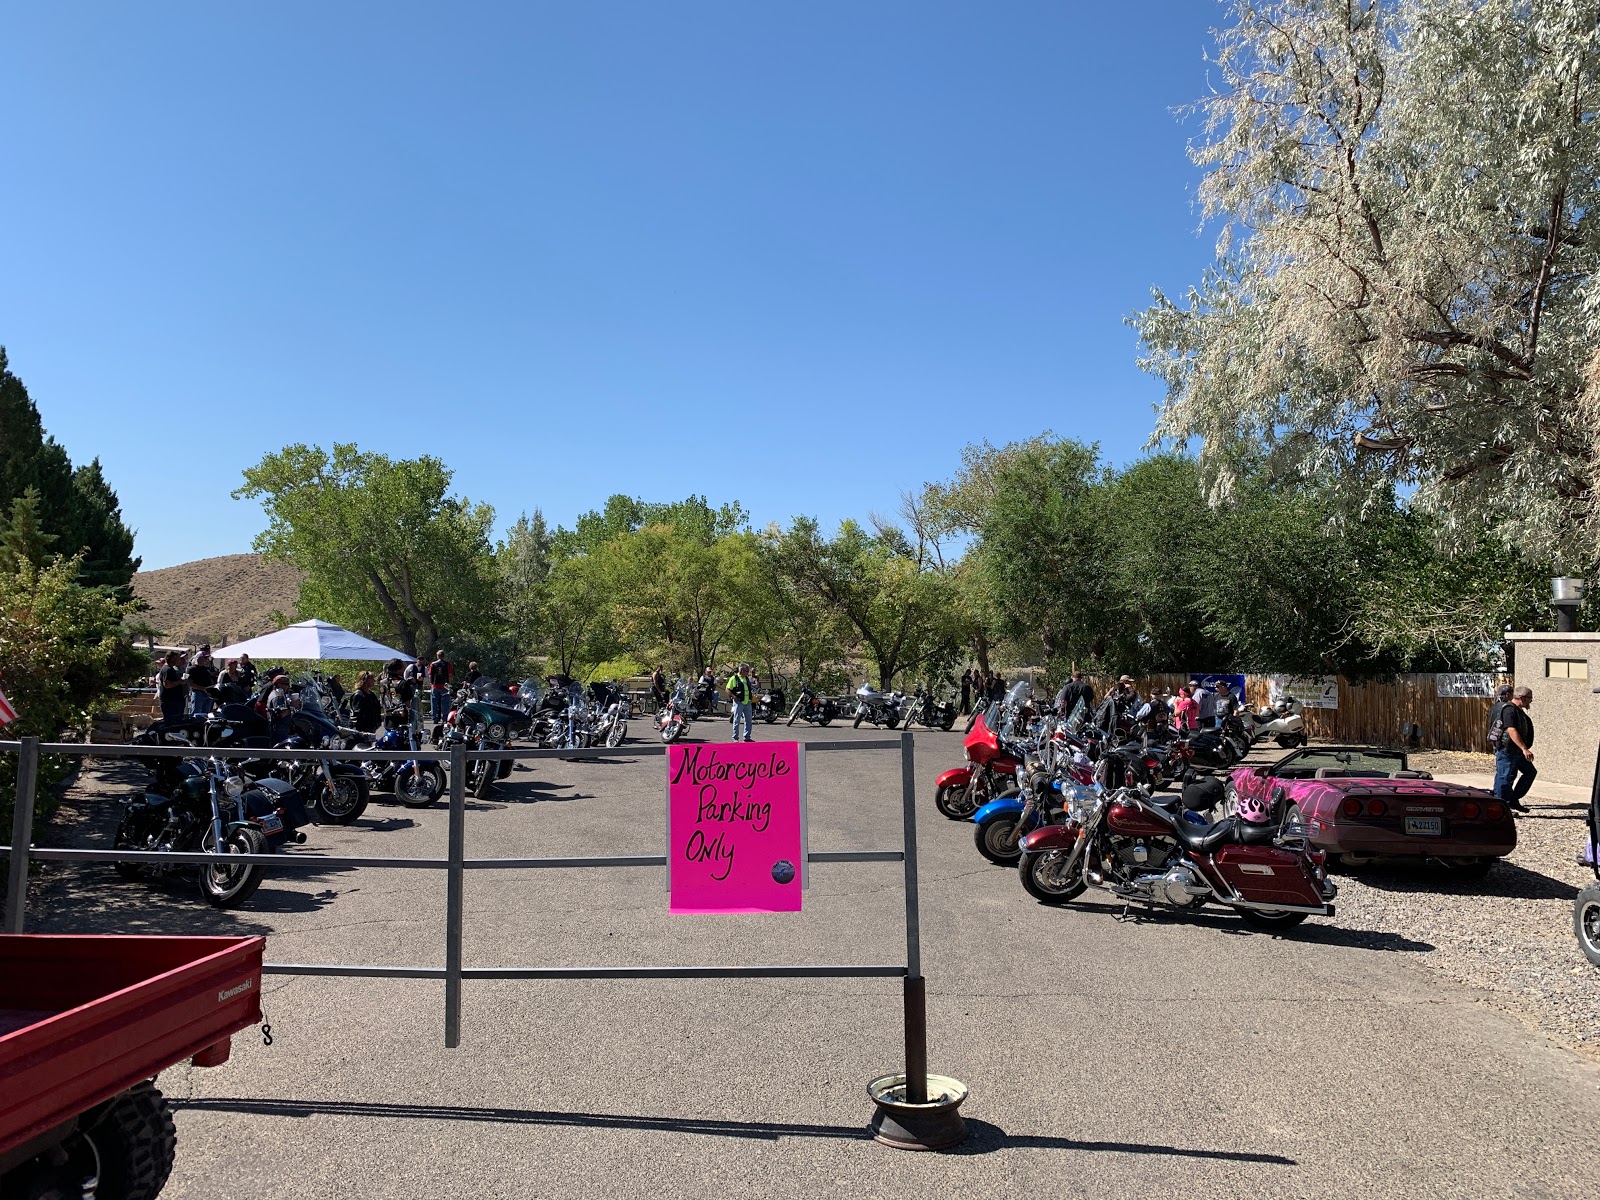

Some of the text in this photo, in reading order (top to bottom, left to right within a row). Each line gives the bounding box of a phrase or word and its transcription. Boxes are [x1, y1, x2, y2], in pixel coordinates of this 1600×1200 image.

[1454, 675, 1481, 684] WELCOME
[1454, 686, 1485, 695] FISHERMEN
[671, 746, 791, 790] Motorcycle
[694, 783, 772, 832] Parking
[218, 978, 252, 1002] Kawasaki
